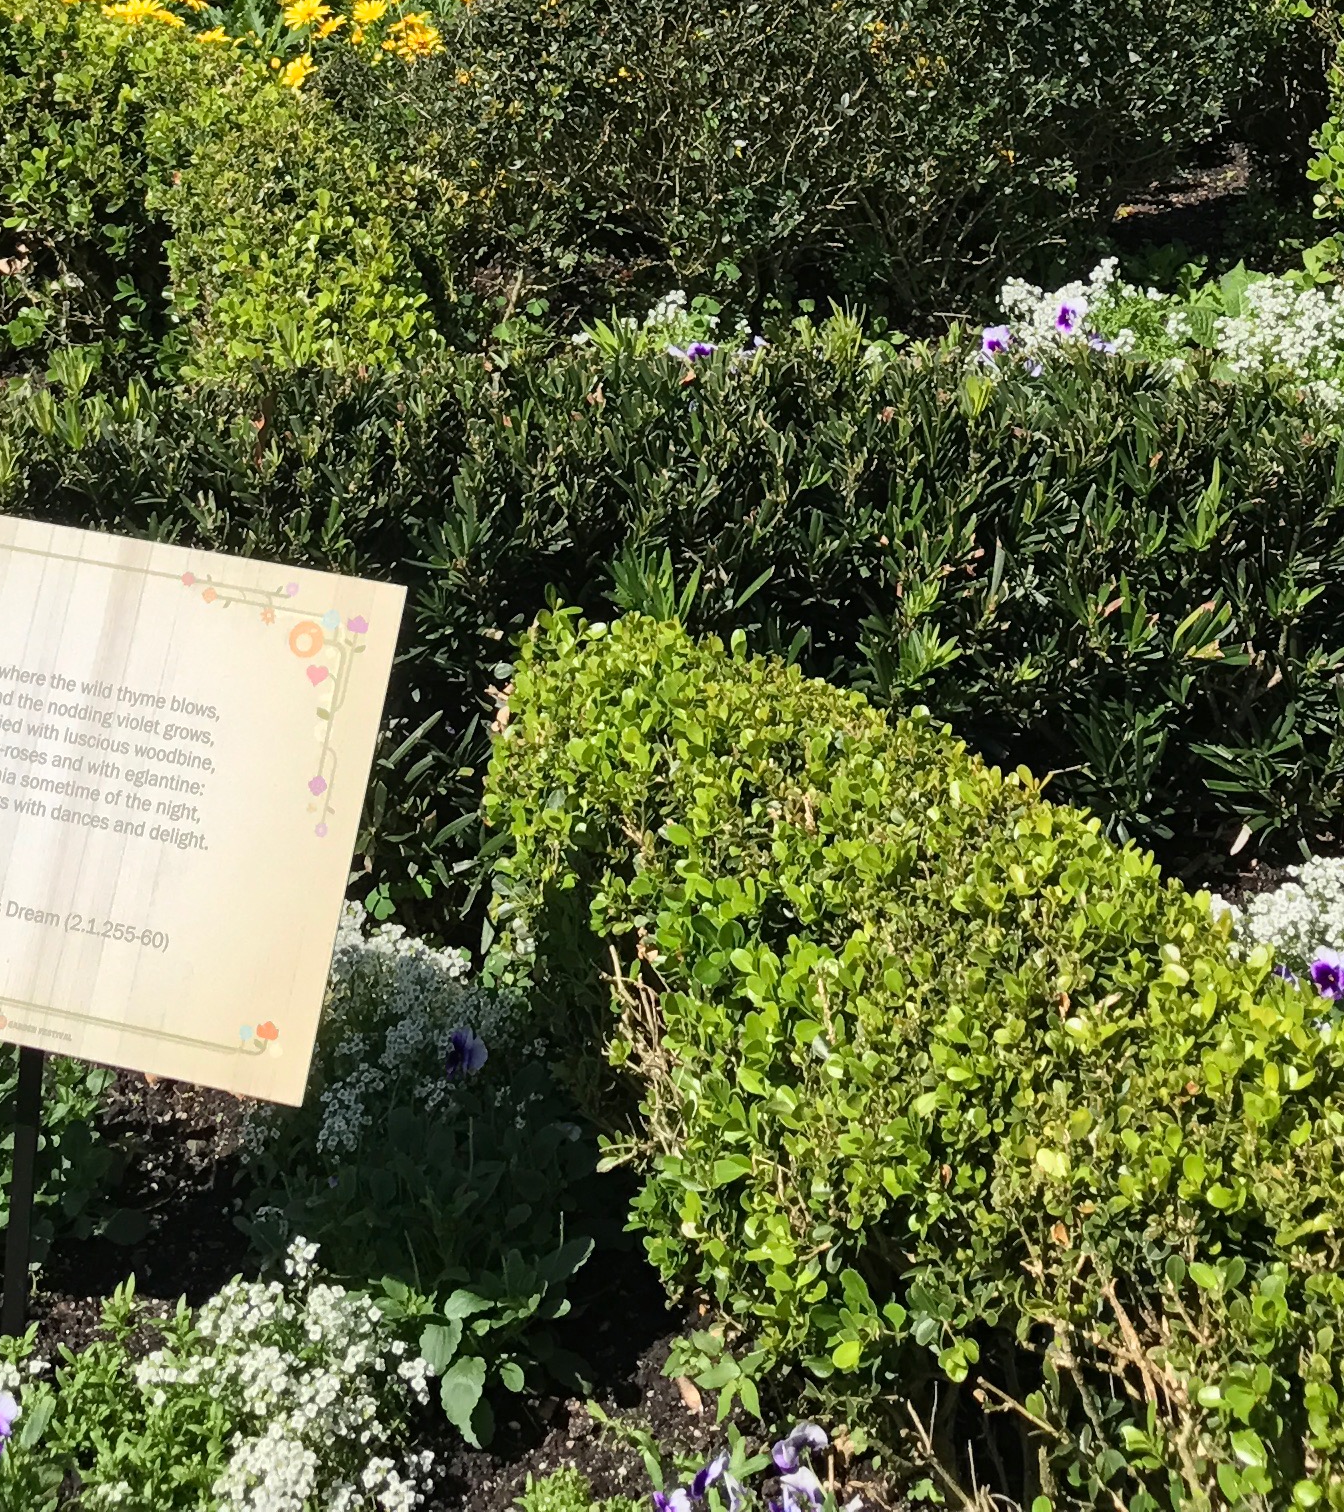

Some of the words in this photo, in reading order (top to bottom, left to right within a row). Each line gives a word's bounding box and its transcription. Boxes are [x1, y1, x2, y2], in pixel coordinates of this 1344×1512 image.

[18, 694, 44, 712] the
[47, 699, 113, 728] nodding
[117, 712, 160, 735] violet
[163, 722, 215, 747] grows,
[50, 673, 77, 692] the
[81, 680, 113, 699] wild
[117, 685, 166, 710] thyme
[170, 695, 221, 722] blows,
[27, 722, 60, 742] with
[63, 727, 130, 755] luscious
[134, 742, 216, 774] woodbine,
[20, 773, 101, 803] sometime
[104, 790, 122, 806] of
[125, 793, 152, 812] the
[156, 800, 202, 824] night,
[51, 754, 82, 772] and
[87, 759, 120, 780] with
[124, 768, 206, 797] eglantine:
[13, 797, 46, 817] with
[50, 805, 109, 830] dances
[113, 819, 145, 838] and
[149, 825, 210, 851] delight.
[5, 900, 61, 927] Dream
[64, 912, 171, 953] (2.1.255-60)
[8, 1020, 38, 1033] GARDEN
[38, 1026, 73, 1041] FESTIVAL
